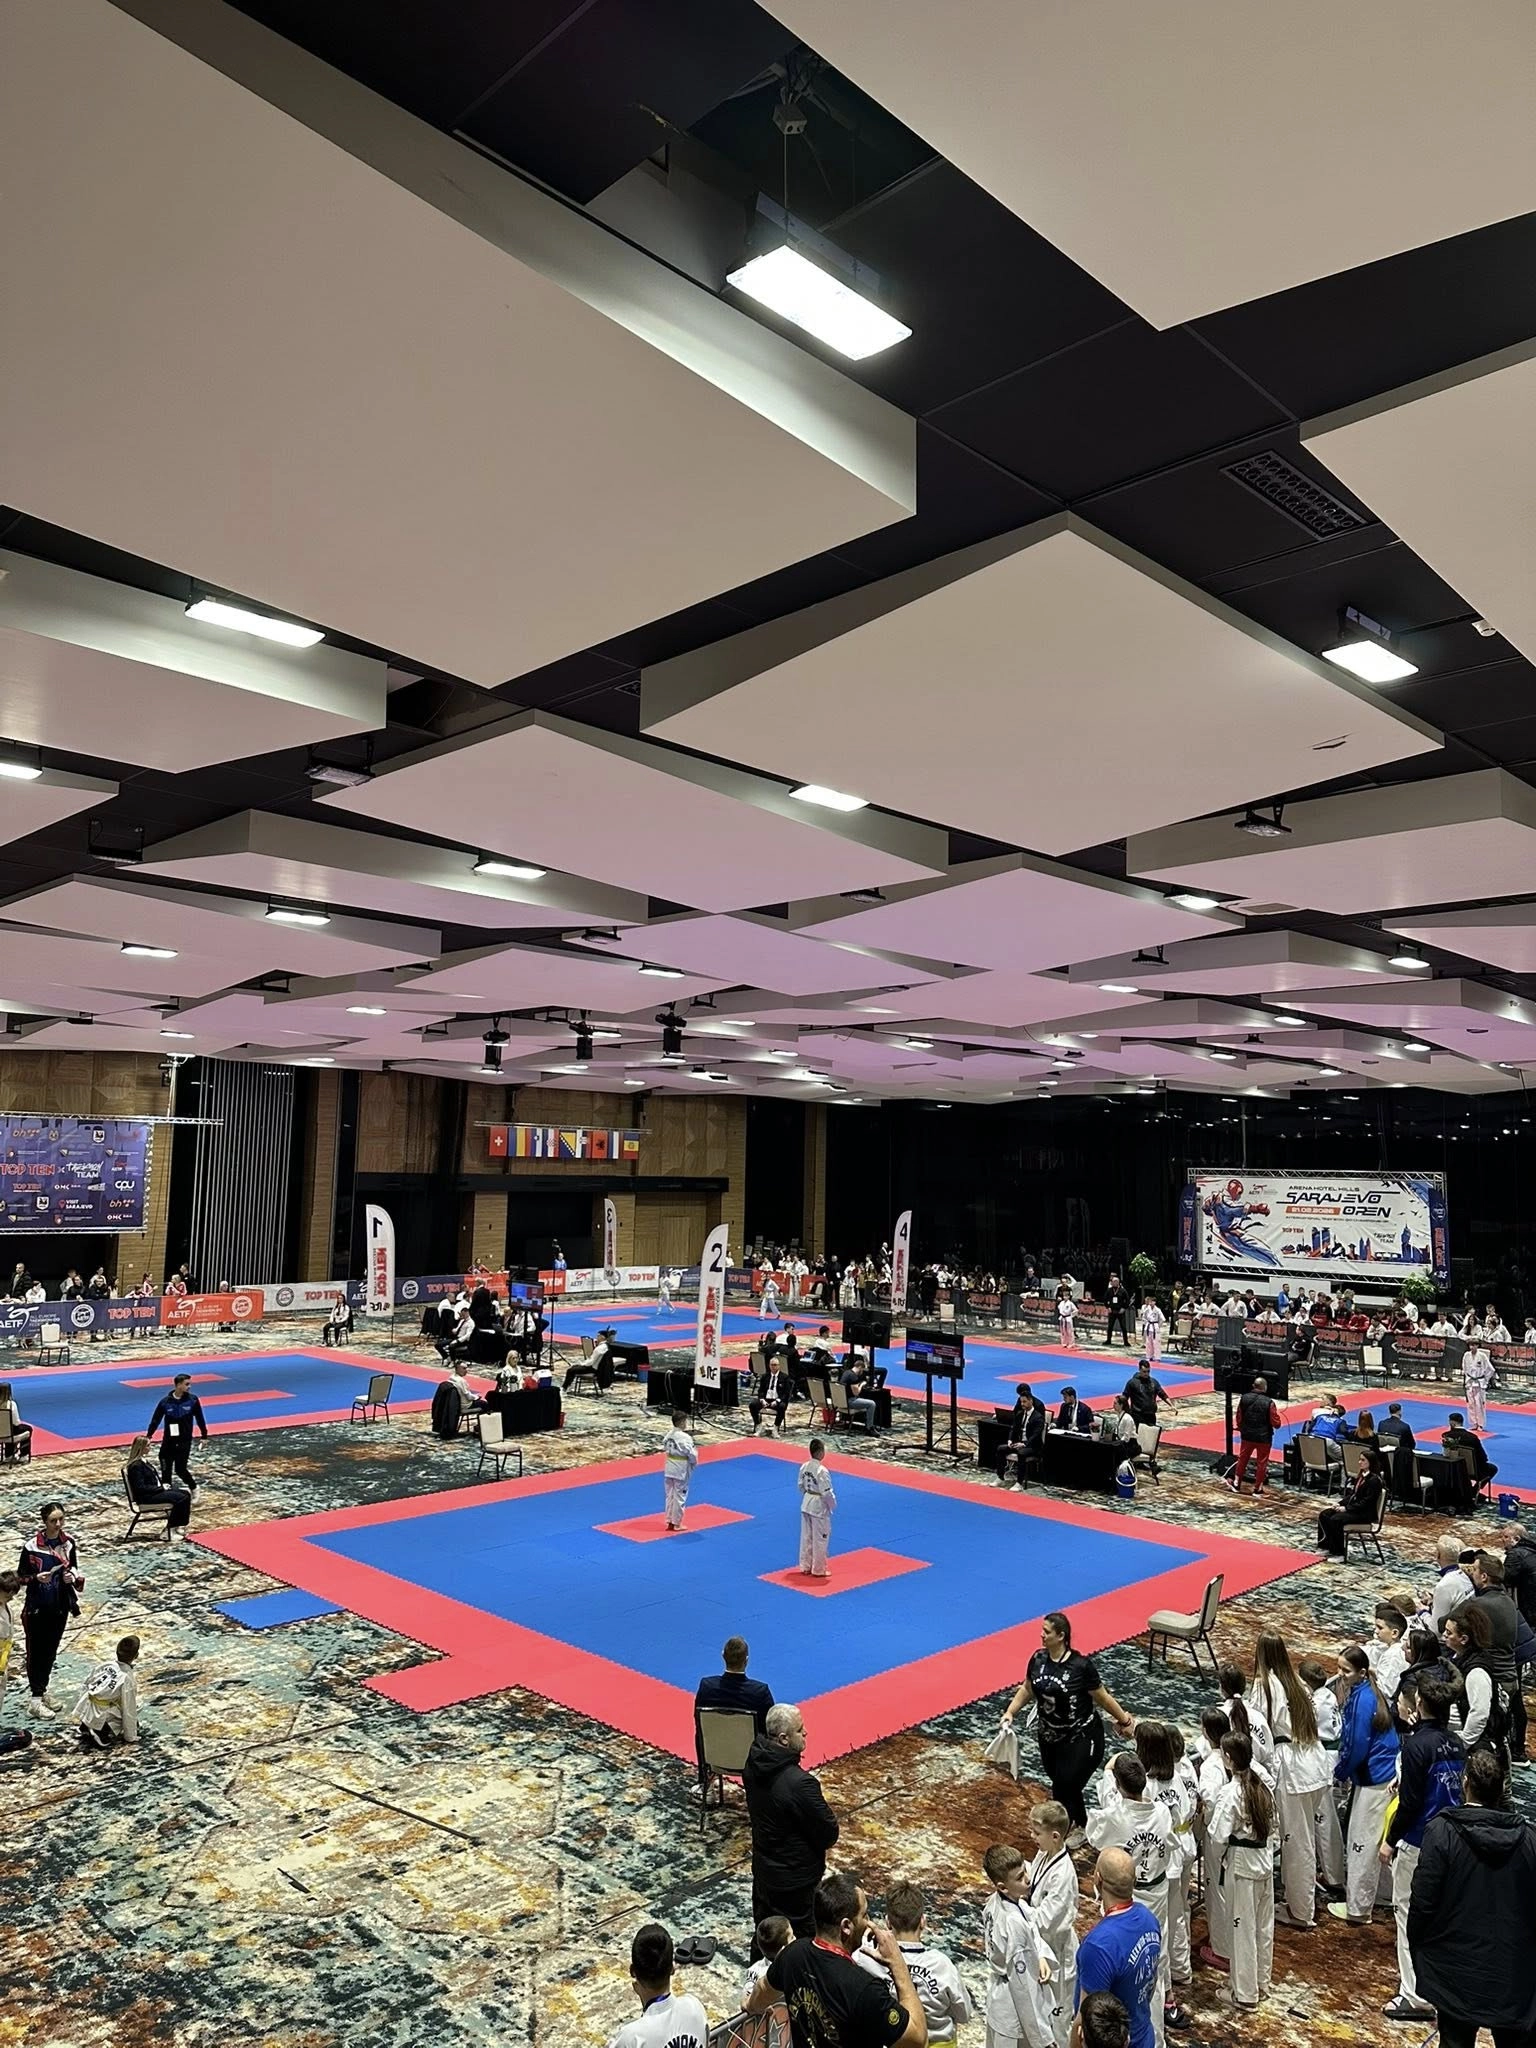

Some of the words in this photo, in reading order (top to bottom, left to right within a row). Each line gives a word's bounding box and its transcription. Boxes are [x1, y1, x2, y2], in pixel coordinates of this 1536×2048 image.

[0, 1163, 26, 1176] TOP
[28, 1163, 56, 1176] TEN
[1277, 1191, 1392, 1205] SARAJEVO
[1342, 1206, 1392, 1218] OPEN
[900, 1222, 908, 1240] 4
[710, 1243, 722, 1272] 2
[628, 1274, 641, 1282] TOP
[427, 1284, 443, 1293] TOP
[304, 1292, 322, 1300] TOP
[108, 1308, 132, 1320] TOP
[132, 1306, 156, 1318] TEN
[168, 1310, 191, 1319] AETF
[1244, 1320, 1266, 1333] TOP
[1266, 1322, 1288, 1336] TEN
[1395, 1336, 1420, 1348] TOP
[1420, 1337, 1446, 1350] TEN
[1124, 1832, 1166, 1858] AEKWON-DO
